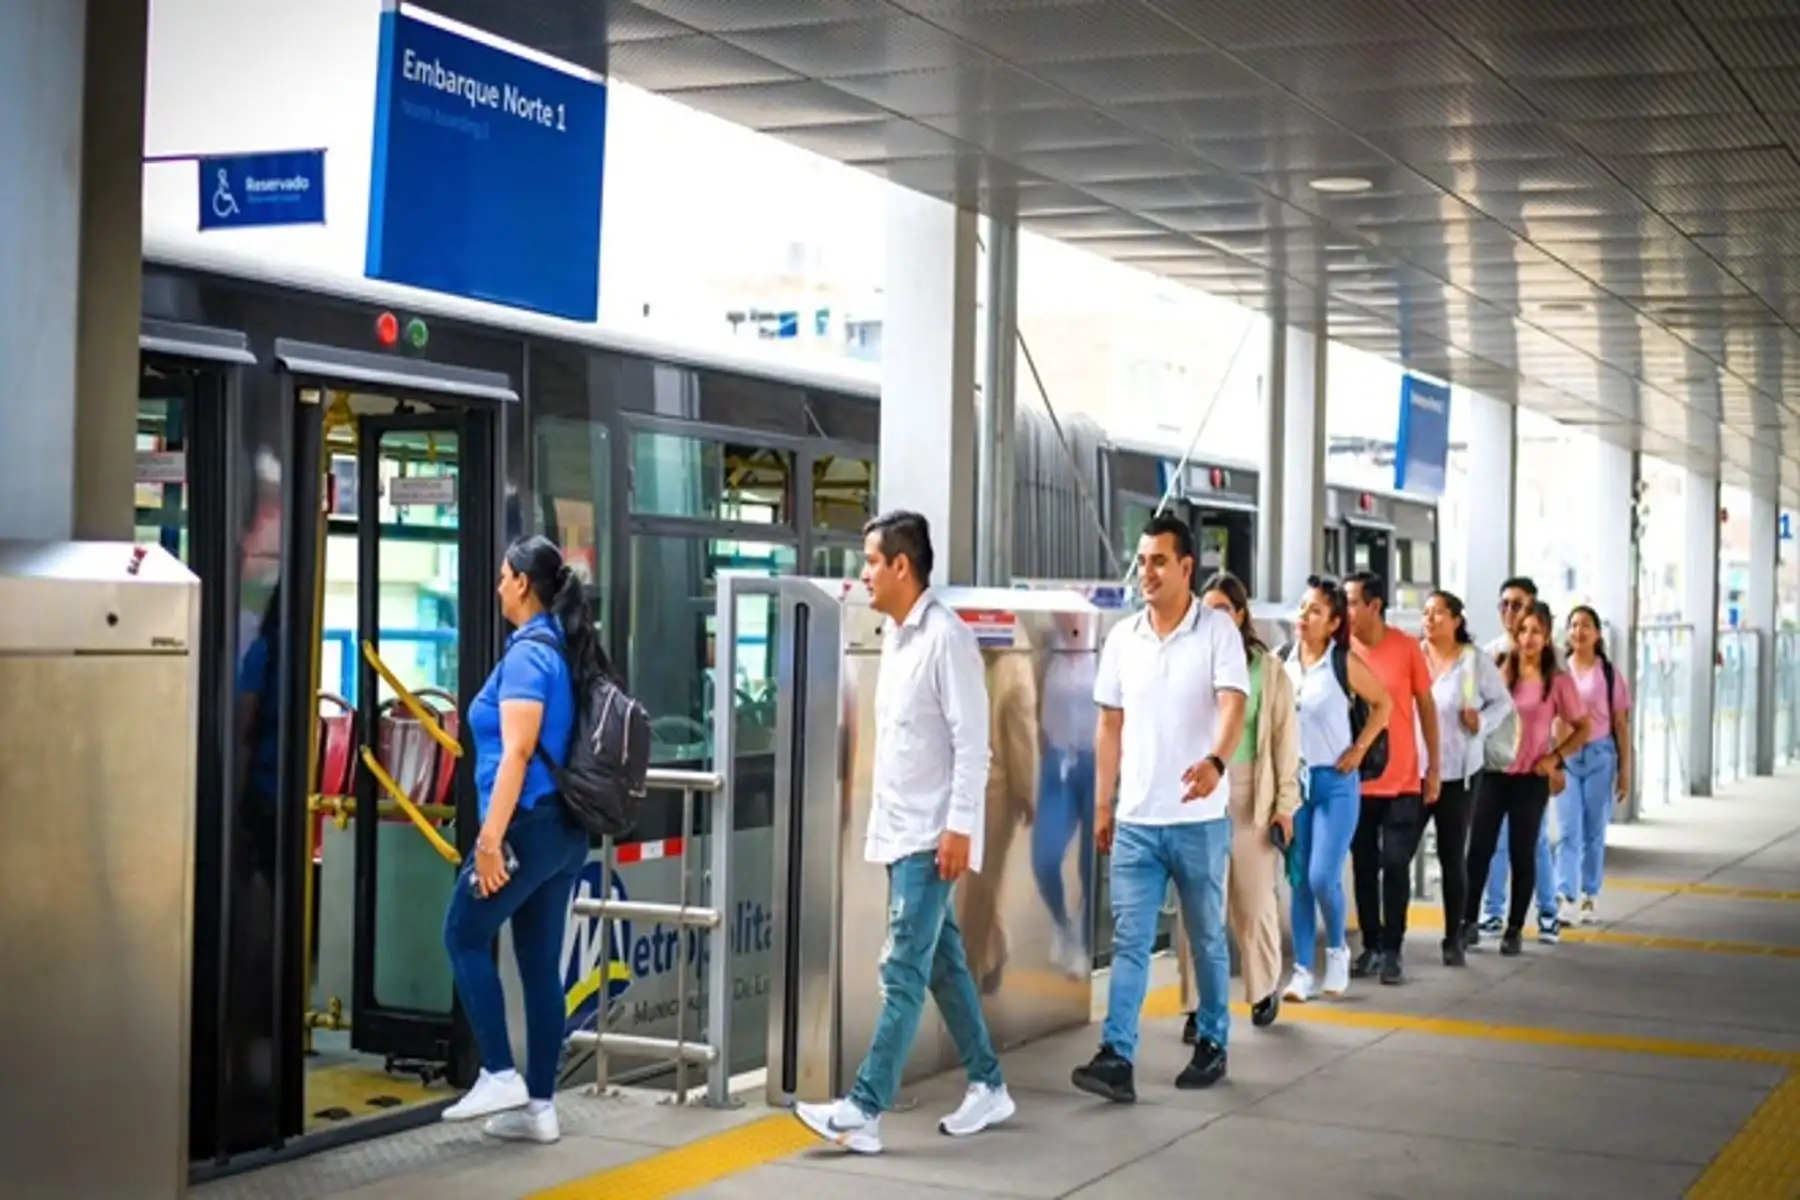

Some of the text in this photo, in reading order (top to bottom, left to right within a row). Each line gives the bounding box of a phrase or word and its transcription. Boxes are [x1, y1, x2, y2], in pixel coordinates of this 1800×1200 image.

[402, 48, 567, 133] Embarque Norte 1
[245, 175, 310, 192] Reservado
